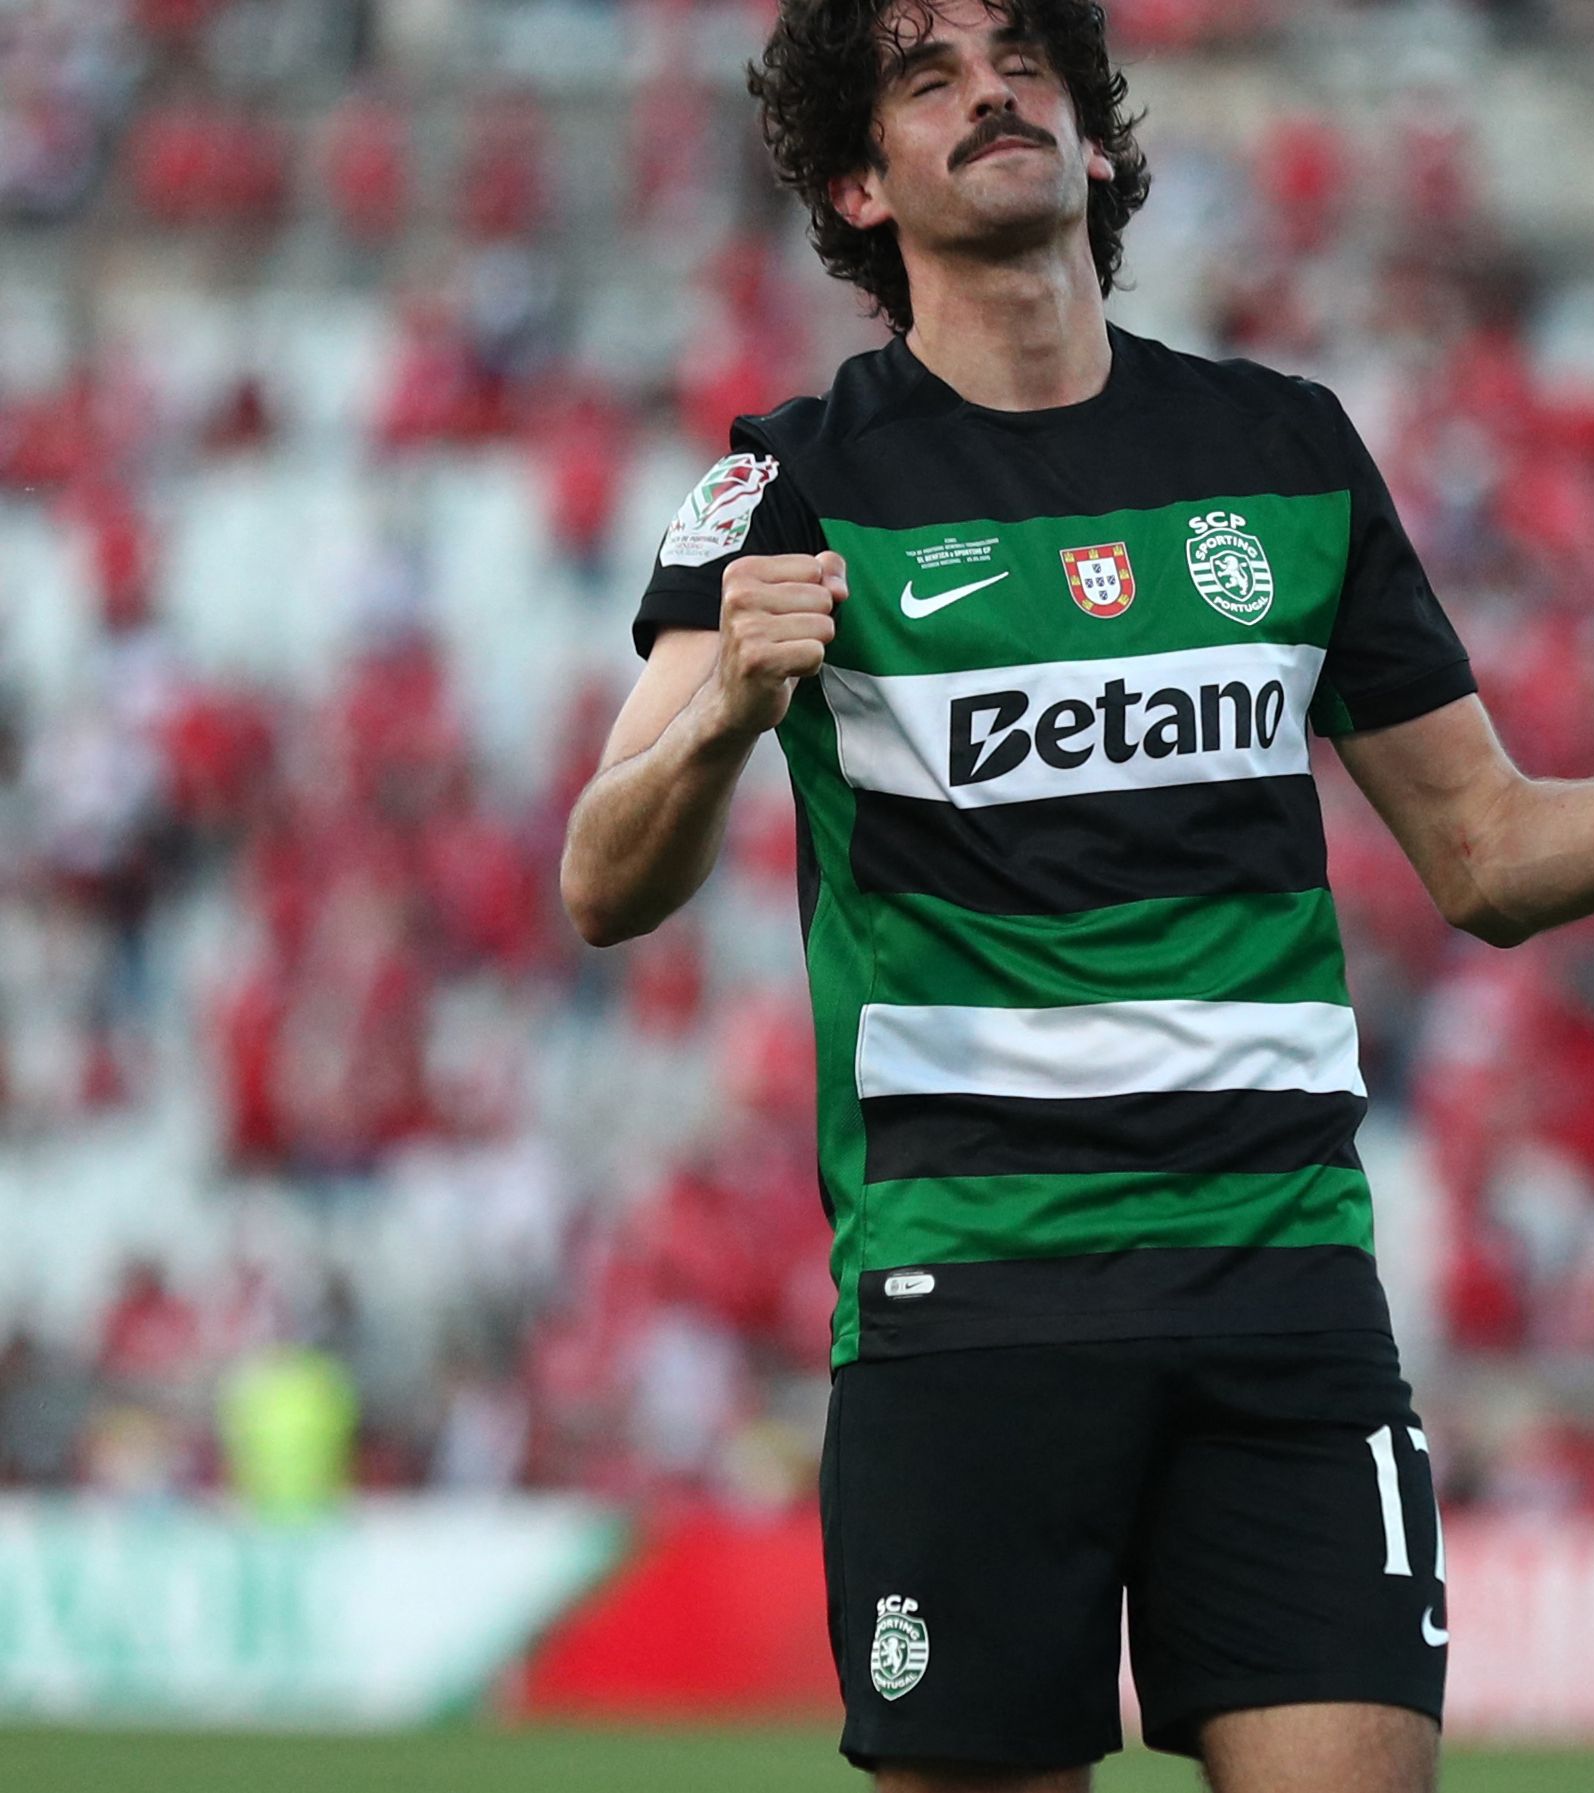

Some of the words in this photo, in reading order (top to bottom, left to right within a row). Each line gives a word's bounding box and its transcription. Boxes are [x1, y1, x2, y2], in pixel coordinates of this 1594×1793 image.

[1188, 511, 1246, 534] SCP
[1195, 535, 1258, 560] SPORTING
[1213, 596, 1269, 613] PORTUGAL
[949, 678, 1285, 787] Betano
[876, 1594, 919, 1616] SCP
